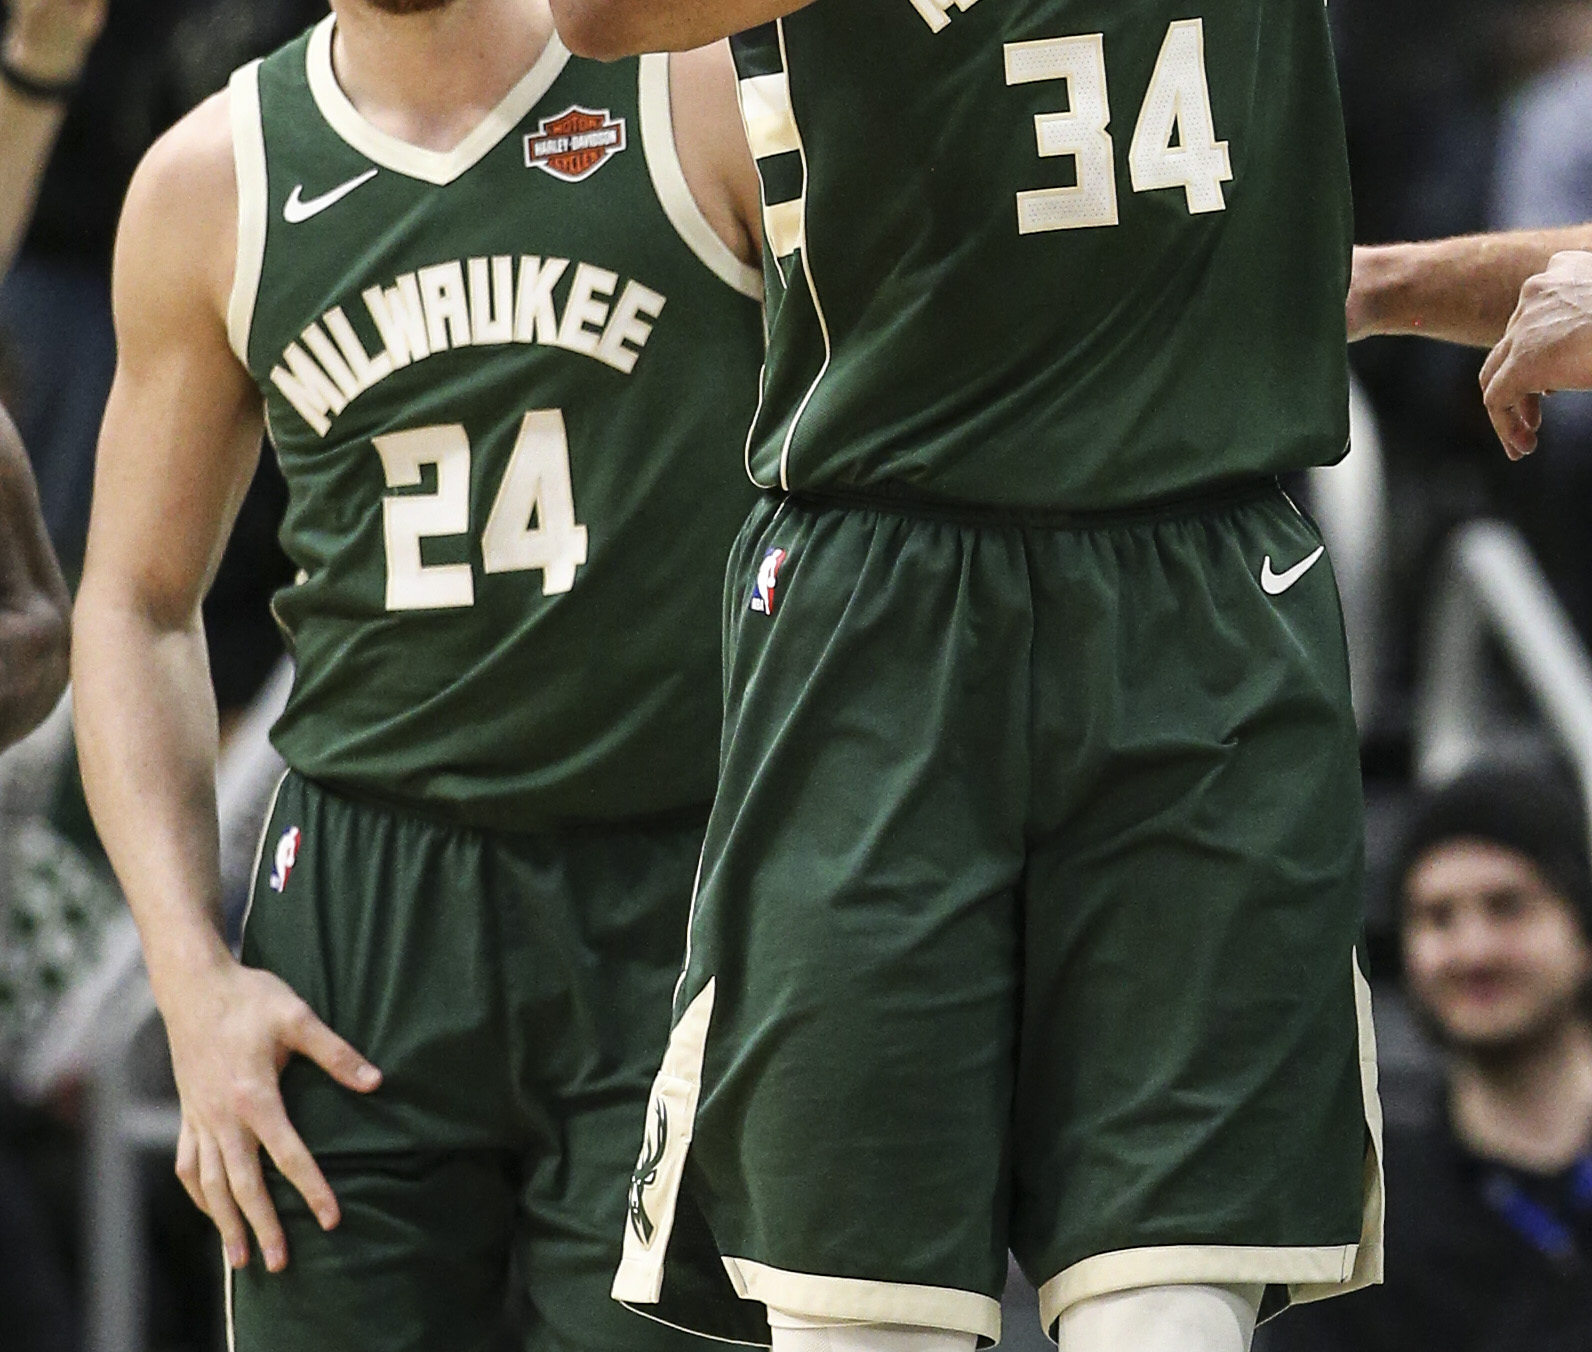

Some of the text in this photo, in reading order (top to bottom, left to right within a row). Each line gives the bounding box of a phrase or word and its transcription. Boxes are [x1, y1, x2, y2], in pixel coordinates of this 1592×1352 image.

[1003, 17, 1233, 235] 34
[269, 255, 667, 437] MILWAUKEE
[371, 408, 588, 611] 24
